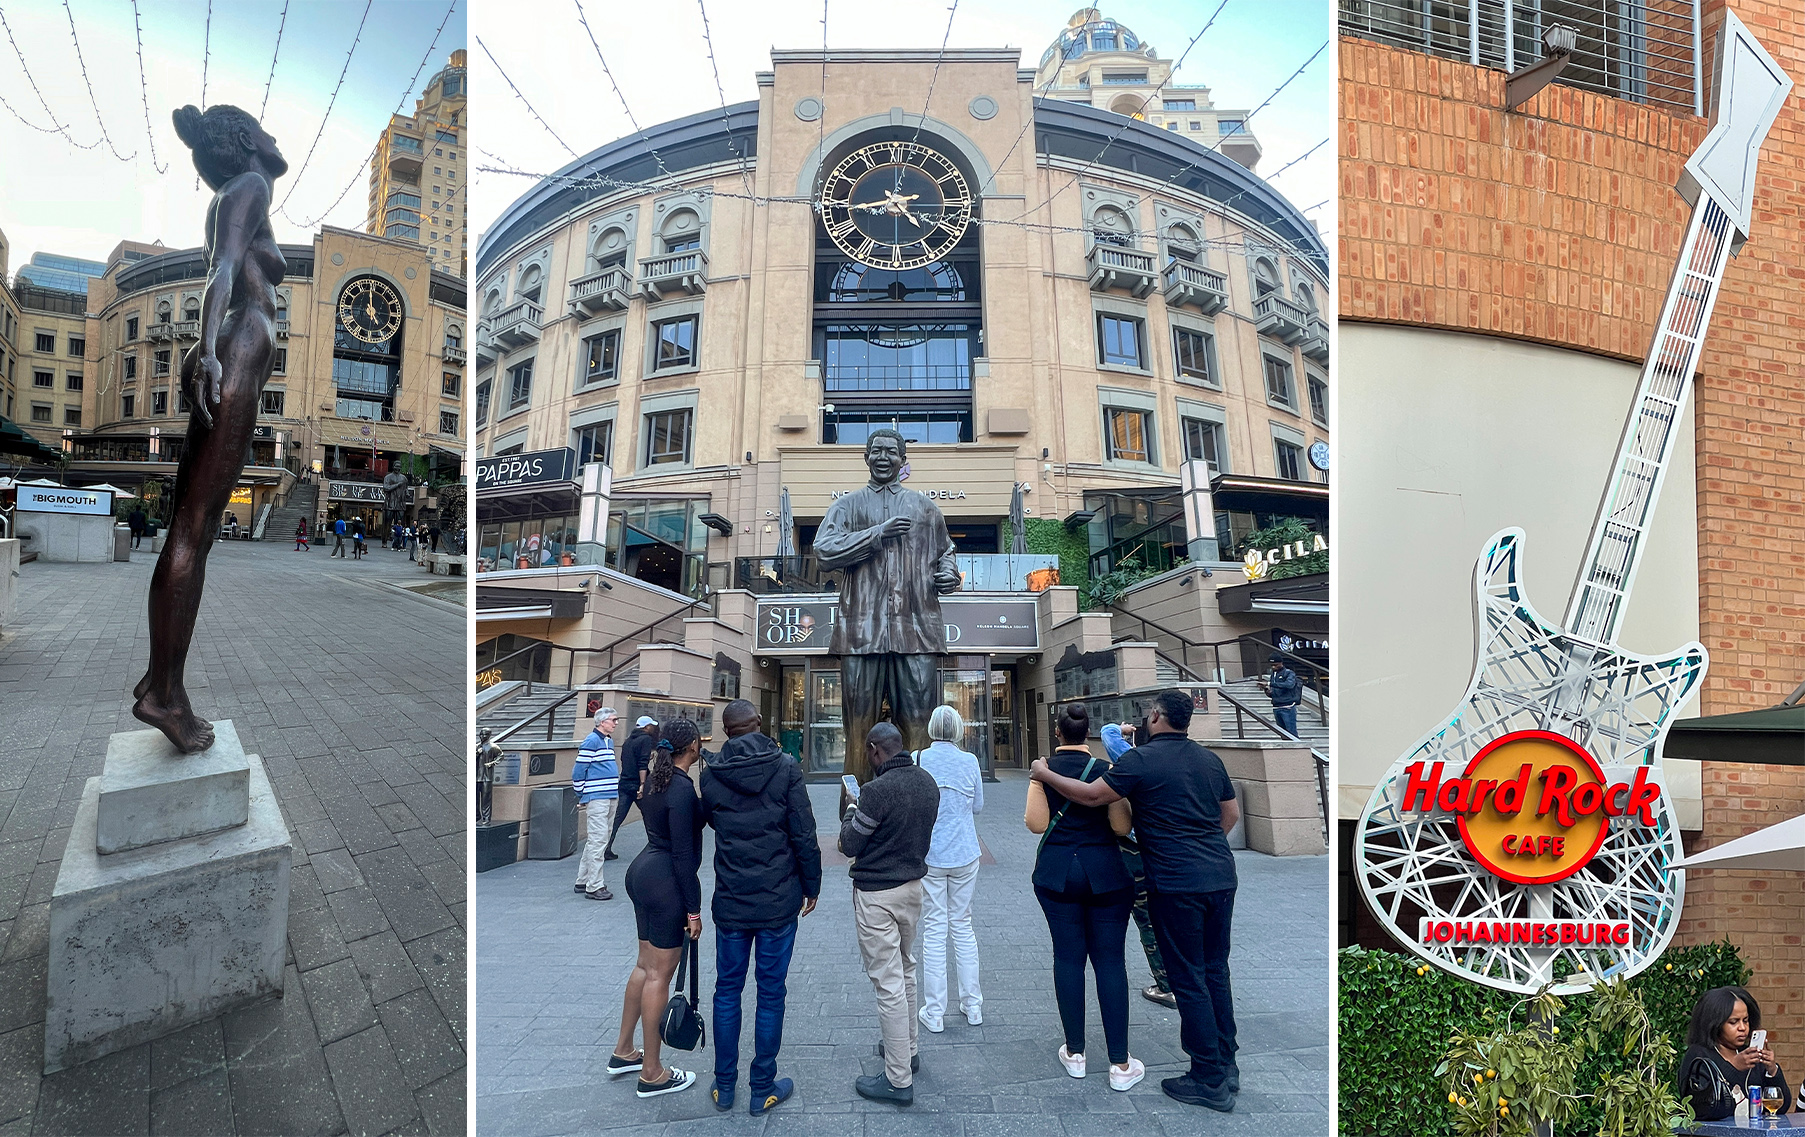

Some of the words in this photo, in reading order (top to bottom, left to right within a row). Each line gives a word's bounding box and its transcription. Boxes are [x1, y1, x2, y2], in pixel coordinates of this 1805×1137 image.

[889, 147, 904, 163] XII
[476, 458, 543, 483] PAPPAS
[918, 489, 967, 500] NDELA
[1266, 534, 1329, 565] CILA
[770, 607, 801, 626] SH
[1401, 762, 1533, 814] Hard
[1536, 764, 1661, 827] Rock
[1502, 834, 1565, 857] CAFE
[1423, 920, 1630, 945] JOHANNESBURG
